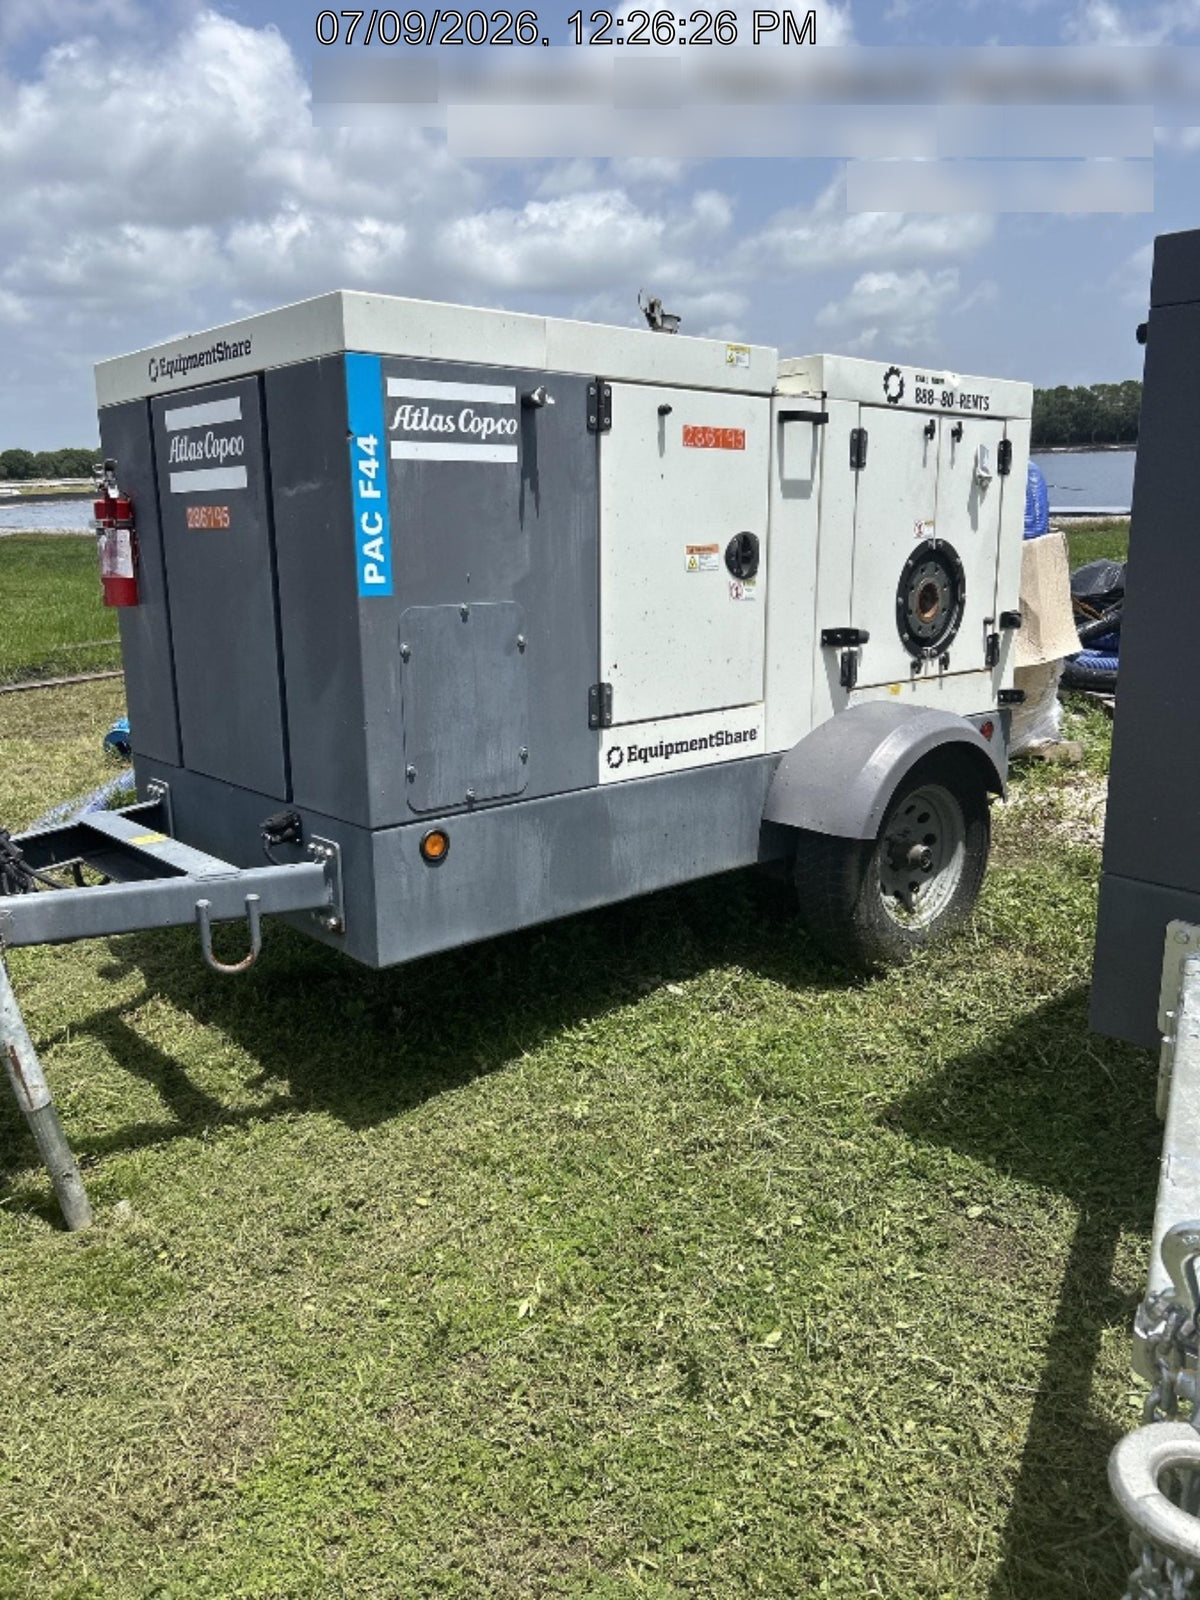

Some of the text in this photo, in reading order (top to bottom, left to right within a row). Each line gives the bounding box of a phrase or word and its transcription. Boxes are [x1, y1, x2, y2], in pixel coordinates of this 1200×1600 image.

[160, 338, 252, 379] EquipmentShare
[389, 404, 518, 440] Atlas Copco
[168, 431, 244, 464] Atlas Copco
[356, 434, 386, 584] PAC F44
[626, 727, 758, 764] EquipmentShare
